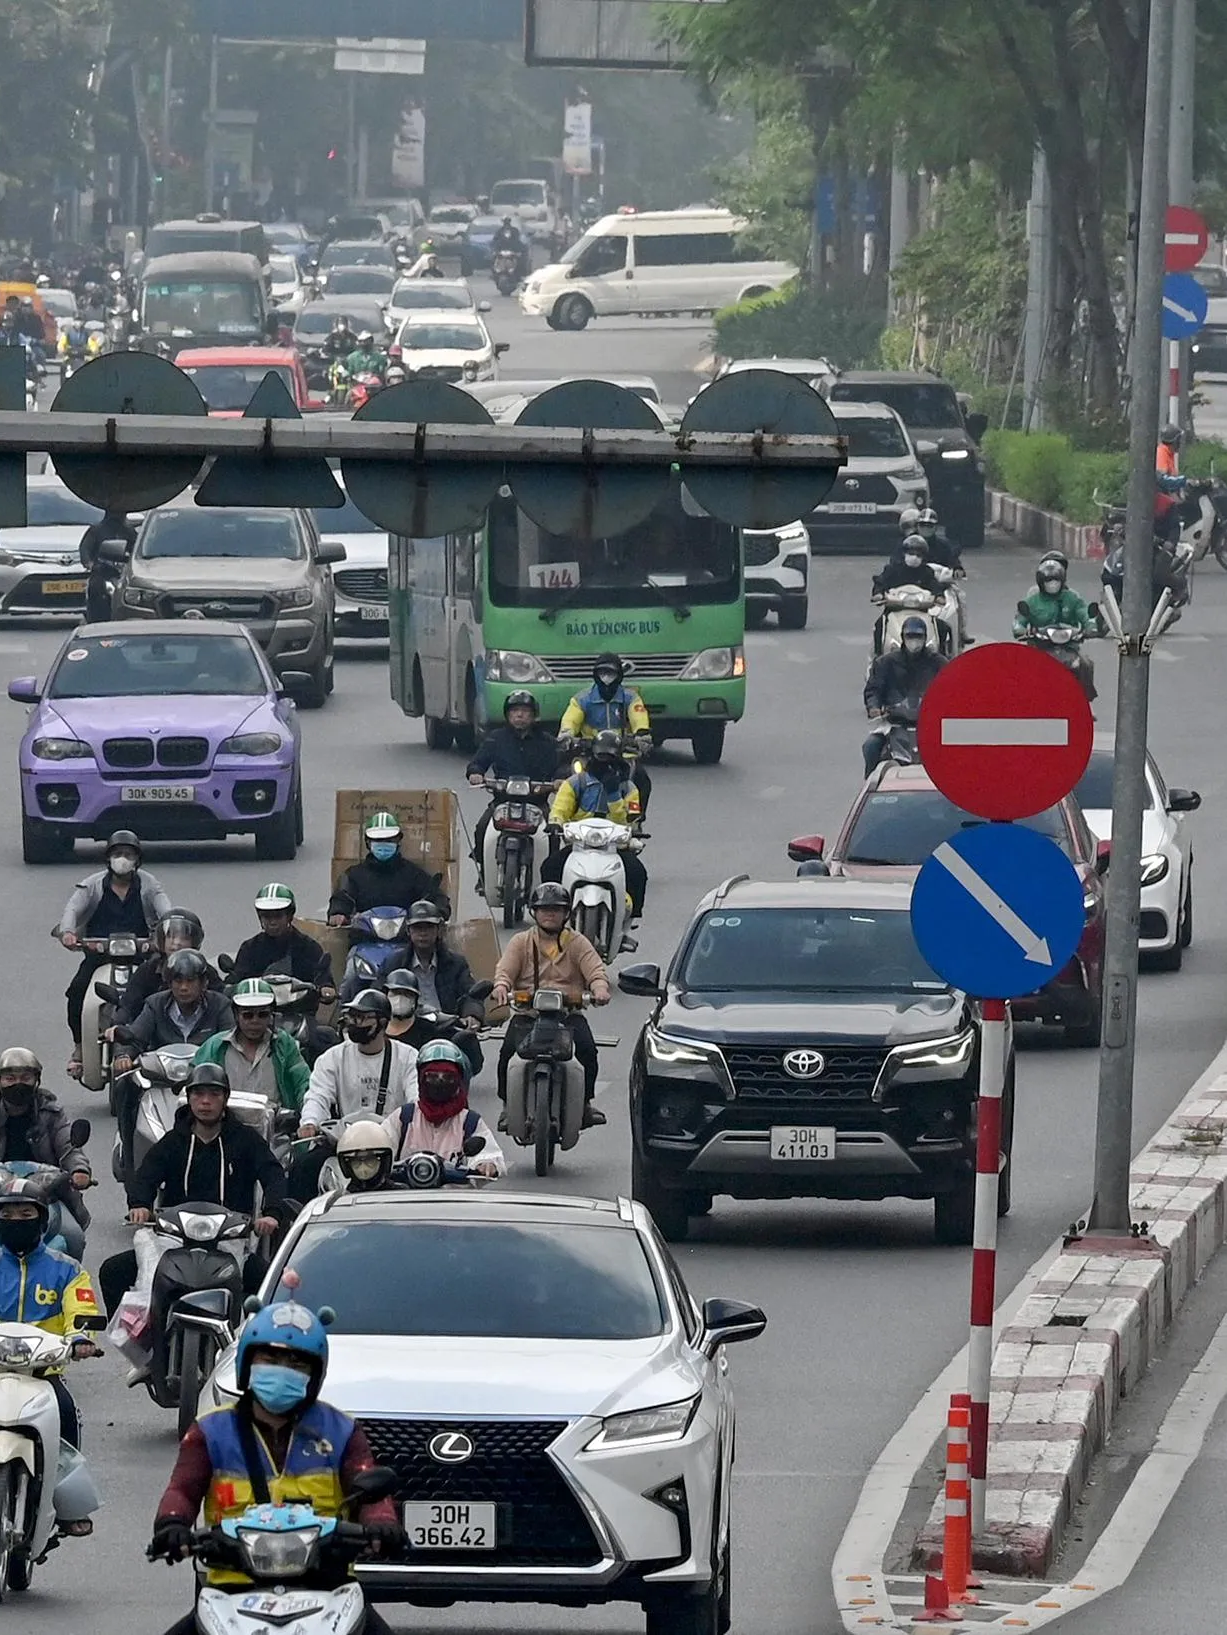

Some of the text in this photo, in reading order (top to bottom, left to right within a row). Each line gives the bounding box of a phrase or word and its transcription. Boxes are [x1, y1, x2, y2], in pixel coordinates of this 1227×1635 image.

[537, 569, 573, 588] 144
[639, 621, 661, 634] BUS
[790, 1129, 817, 1143] 30H
[778, 1144, 828, 1158] 411.03
[431, 1505, 470, 1524] 30H
[414, 1527, 485, 1546] 366.42
